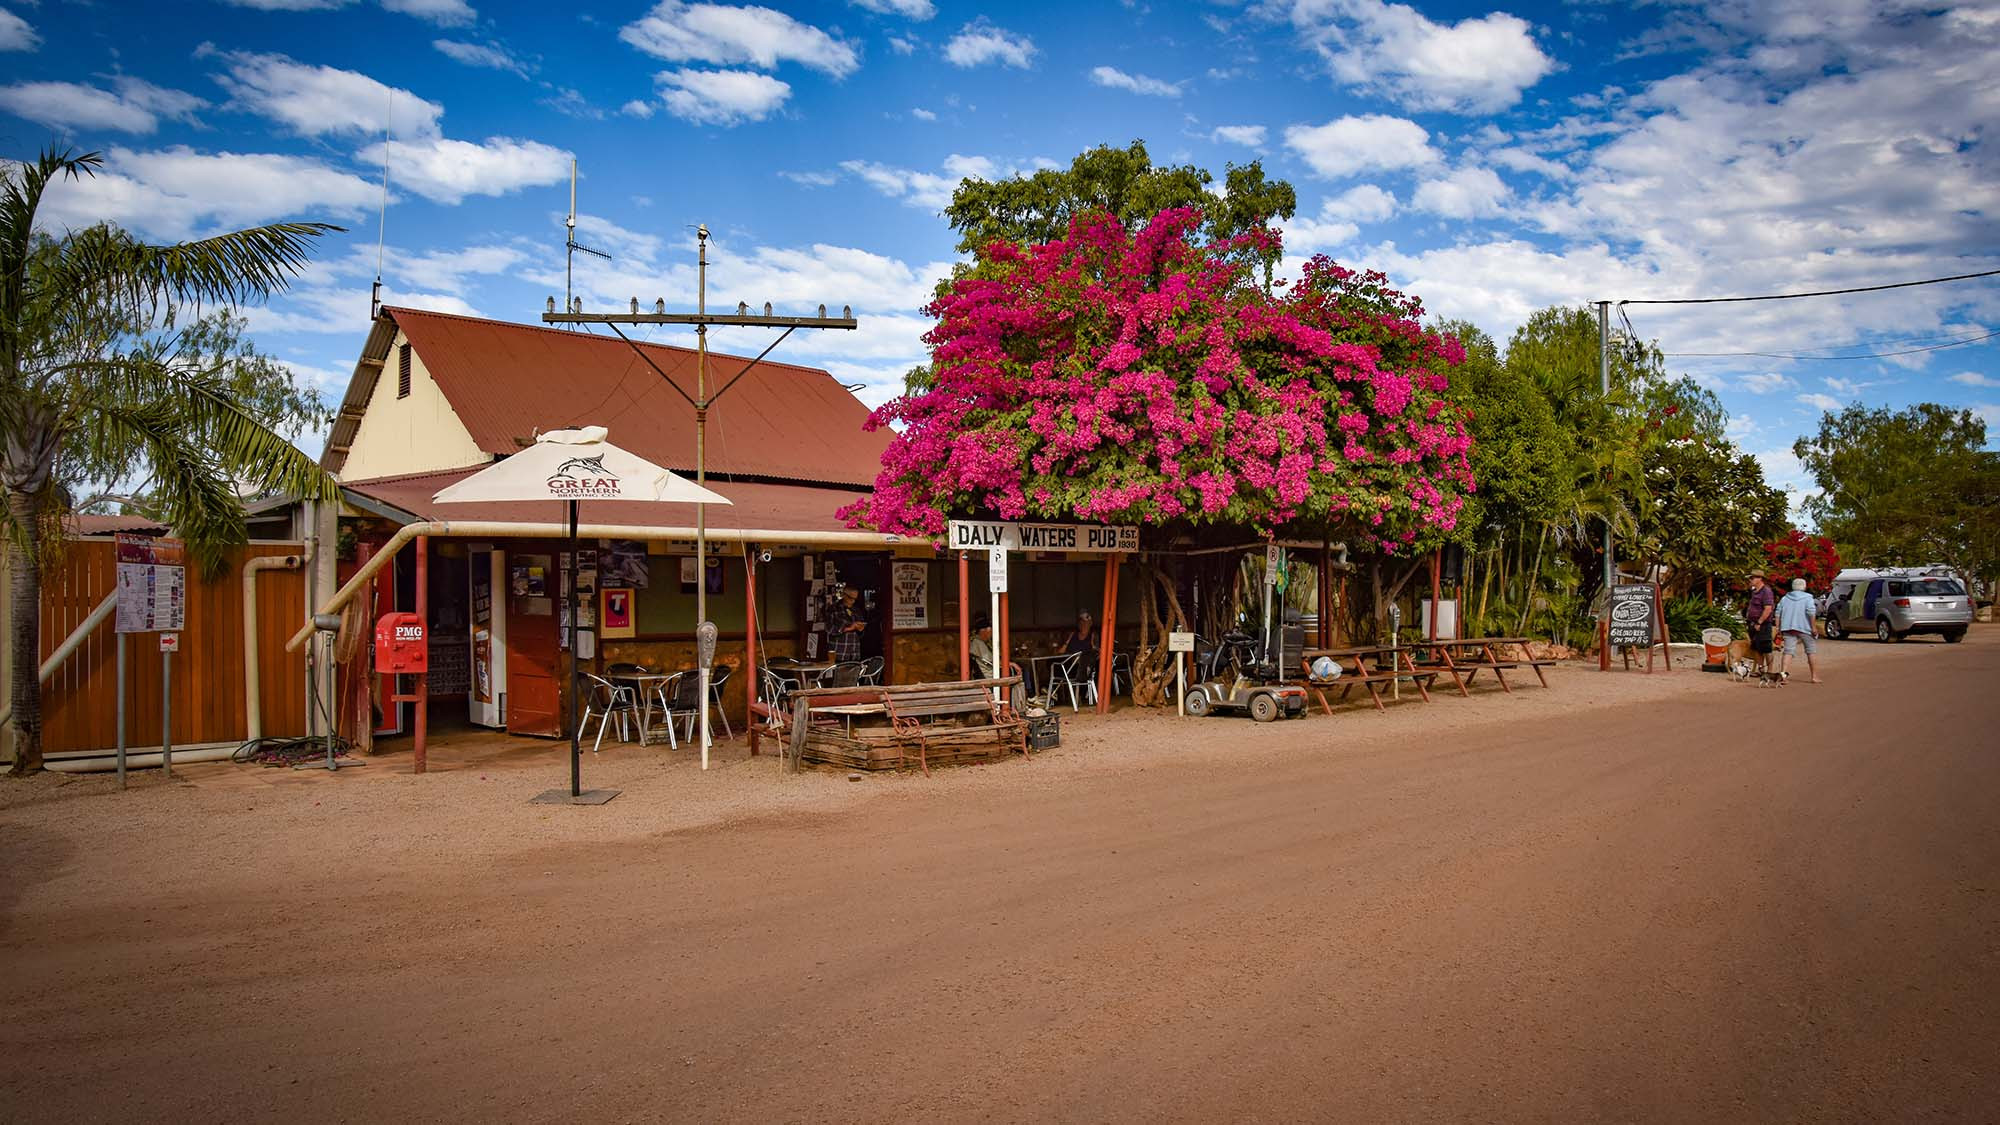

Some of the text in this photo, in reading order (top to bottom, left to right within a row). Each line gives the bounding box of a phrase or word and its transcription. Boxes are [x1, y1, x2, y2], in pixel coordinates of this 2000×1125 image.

[547, 478, 621, 488] GREAT
[957, 525, 1117, 548] DALY WATERS PUB
[1119, 528, 1137, 539] EST.
[1118, 540, 1136, 548] 1930
[611, 593, 626, 611] T
[396, 626, 422, 636] PMG
